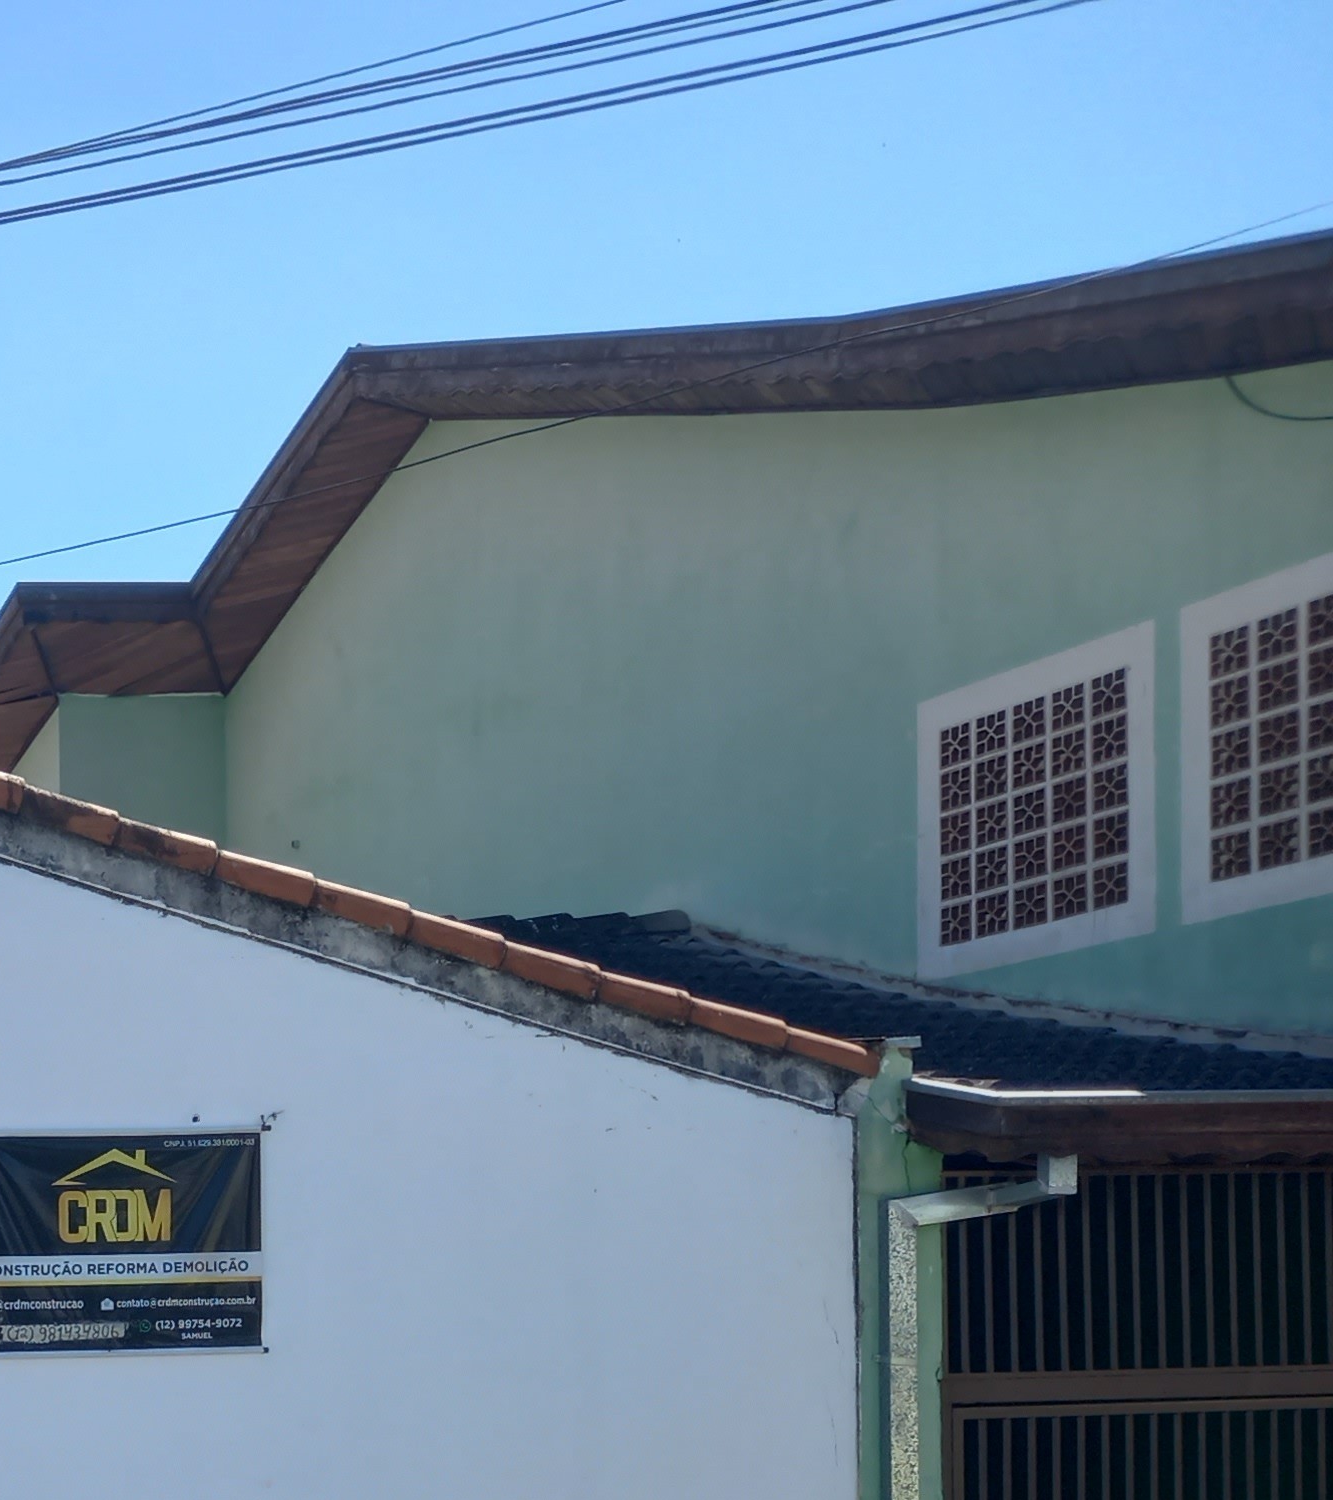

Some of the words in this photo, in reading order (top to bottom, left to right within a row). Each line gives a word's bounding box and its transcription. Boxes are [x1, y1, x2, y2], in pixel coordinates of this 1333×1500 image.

[58, 1188, 171, 1243] CRDM
[87, 1261, 159, 1275] REFORMA
[163, 1257, 249, 1275] DEMOLIÇÃO
[155, 1320, 175, 1331] (12)
